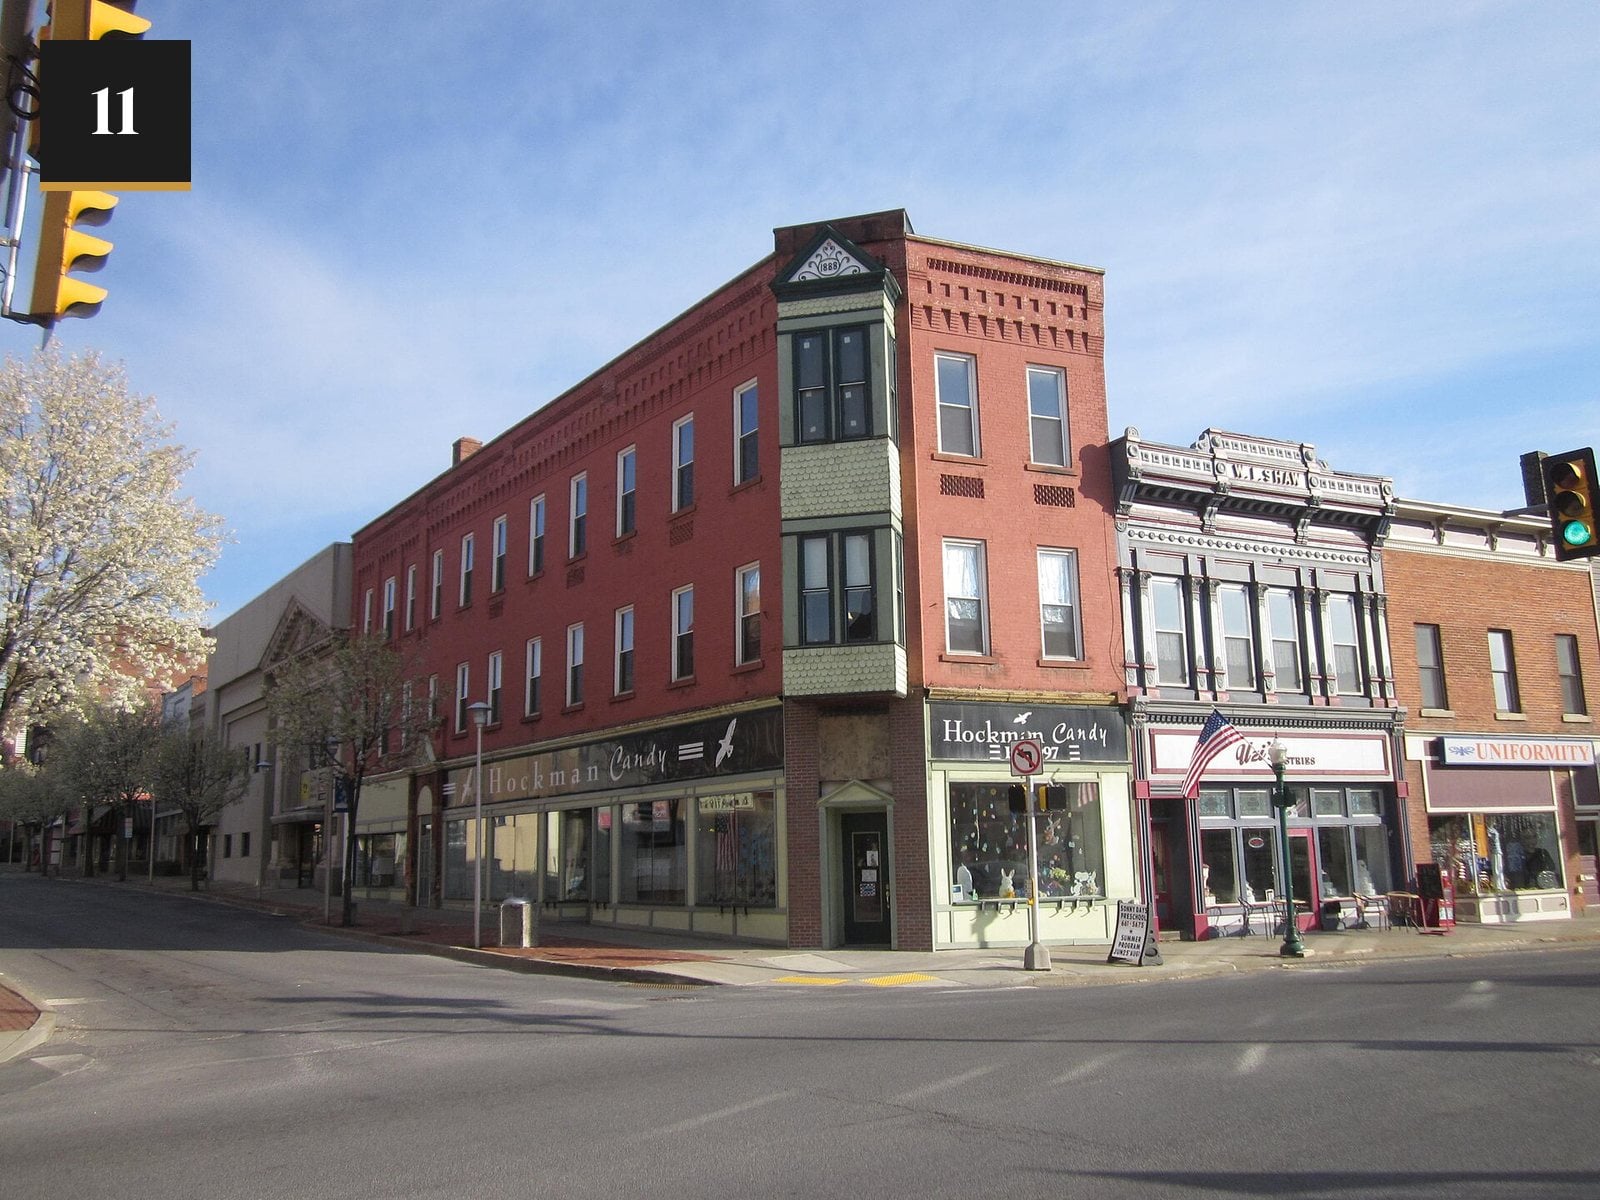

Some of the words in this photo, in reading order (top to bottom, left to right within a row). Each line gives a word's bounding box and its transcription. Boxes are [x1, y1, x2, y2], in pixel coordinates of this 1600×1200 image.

[820, 261, 838, 272] 1888
[1052, 722, 1107, 747] Candy
[1475, 742, 1589, 761] UNIFORMITY
[1283, 756, 1316, 766] STRIES
[489, 761, 599, 795] Hockman
[610, 744, 667, 781] Candy
[1120, 912, 1147, 921] PRESCHOOL
[1121, 934, 1142, 942] SUMMER
[1118, 941, 1141, 950] PROGRAM
